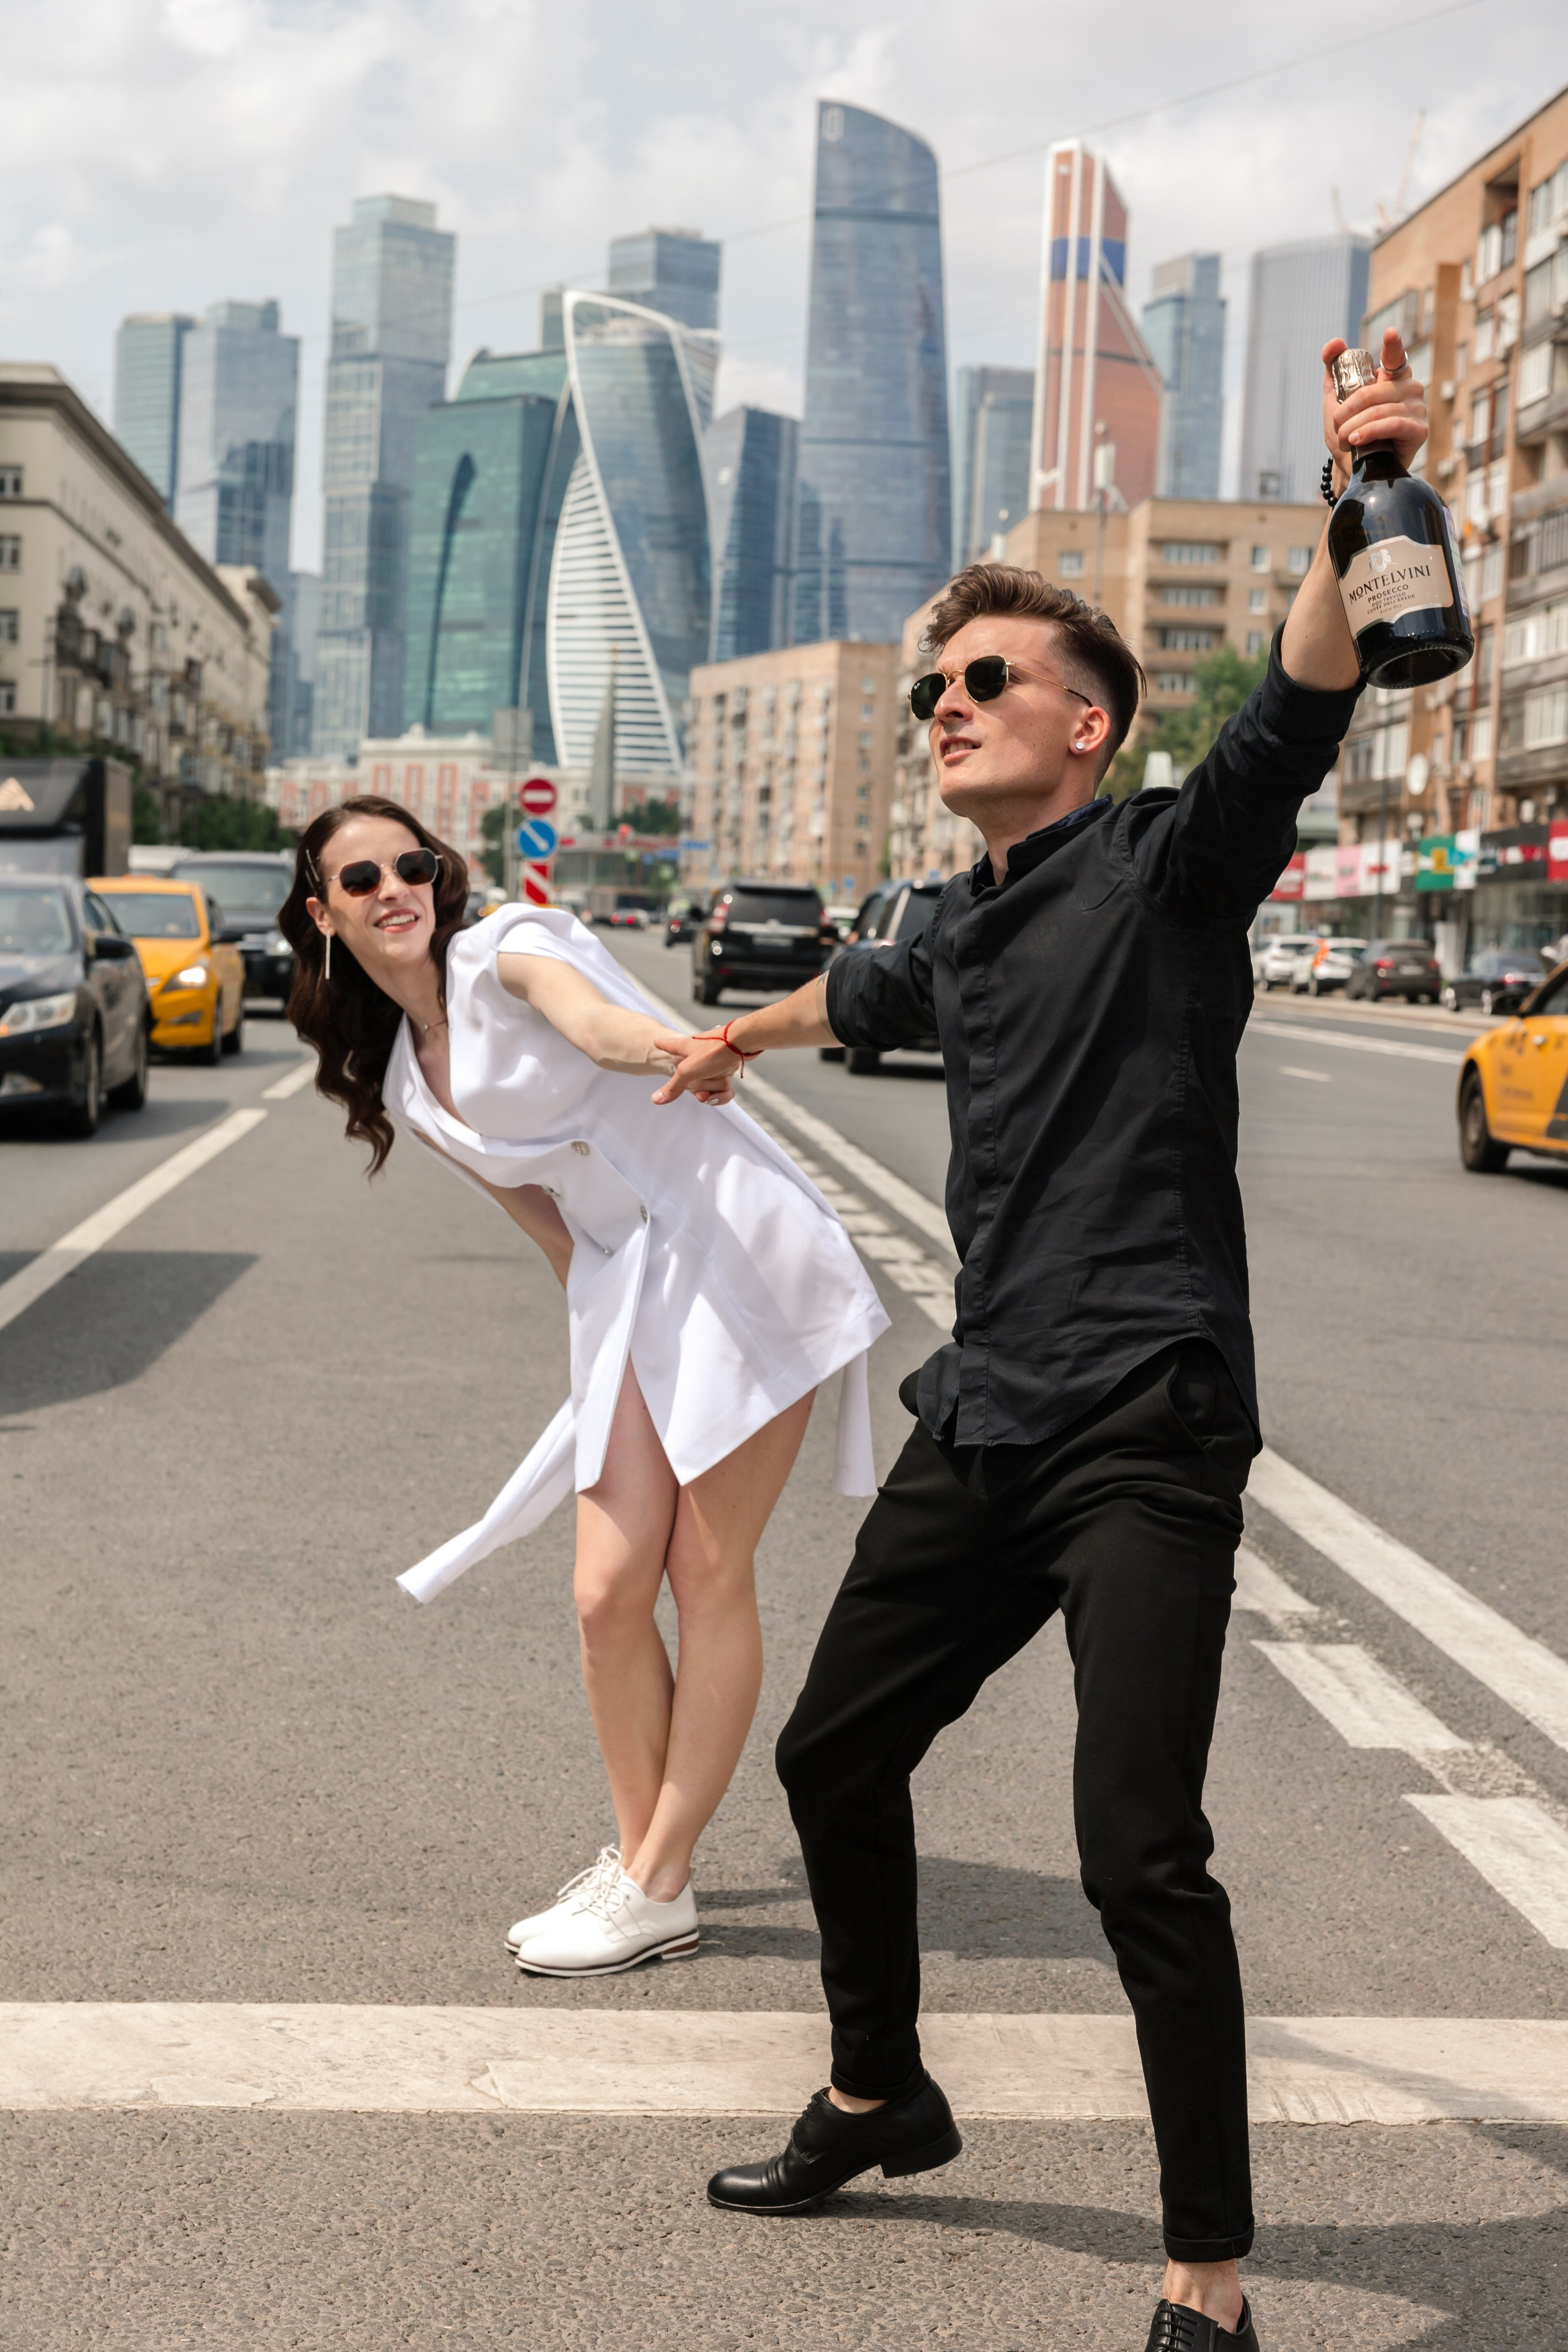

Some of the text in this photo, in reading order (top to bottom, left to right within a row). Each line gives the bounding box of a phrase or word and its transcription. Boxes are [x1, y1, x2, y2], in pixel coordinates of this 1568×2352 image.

[1349, 565, 1431, 605] MONTELVINI
[1368, 584, 1409, 603] PROSECCO
[1384, 592, 1406, 602] TREVISO
